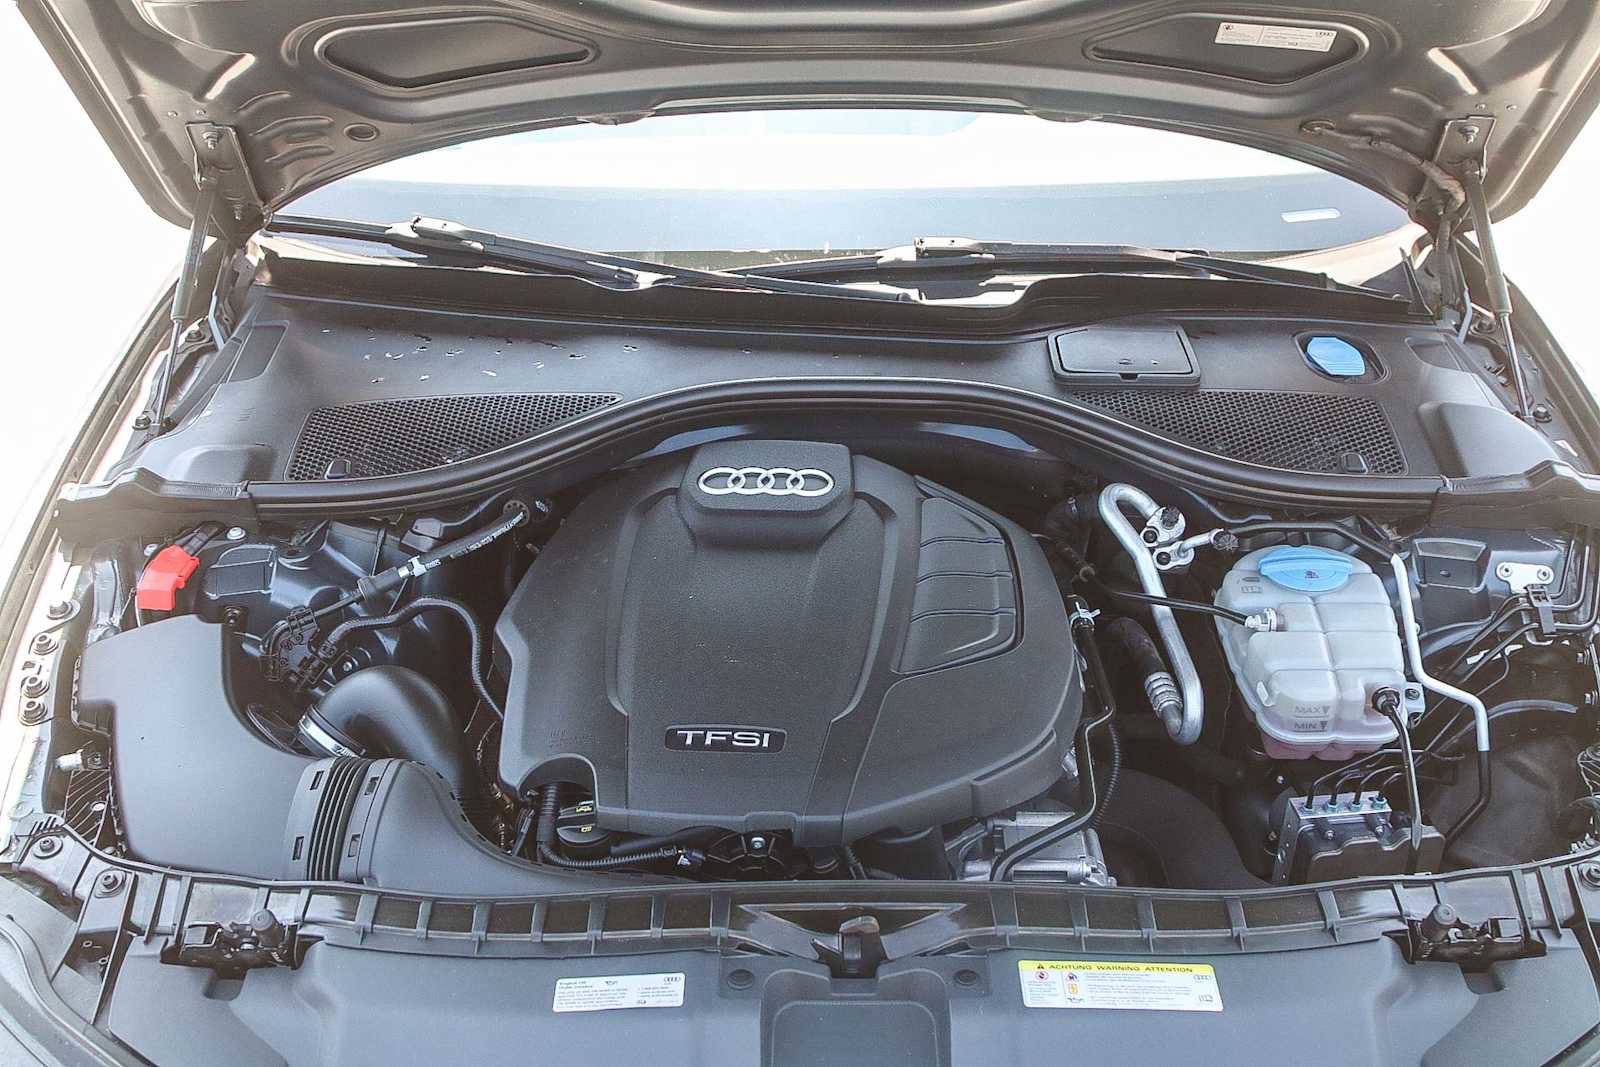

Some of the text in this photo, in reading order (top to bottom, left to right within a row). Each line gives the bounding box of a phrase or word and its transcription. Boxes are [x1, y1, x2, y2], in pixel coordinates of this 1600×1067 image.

[1294, 705, 1321, 713] MAX
[1294, 721, 1317, 729] MIN
[677, 730, 770, 748] TFSI
